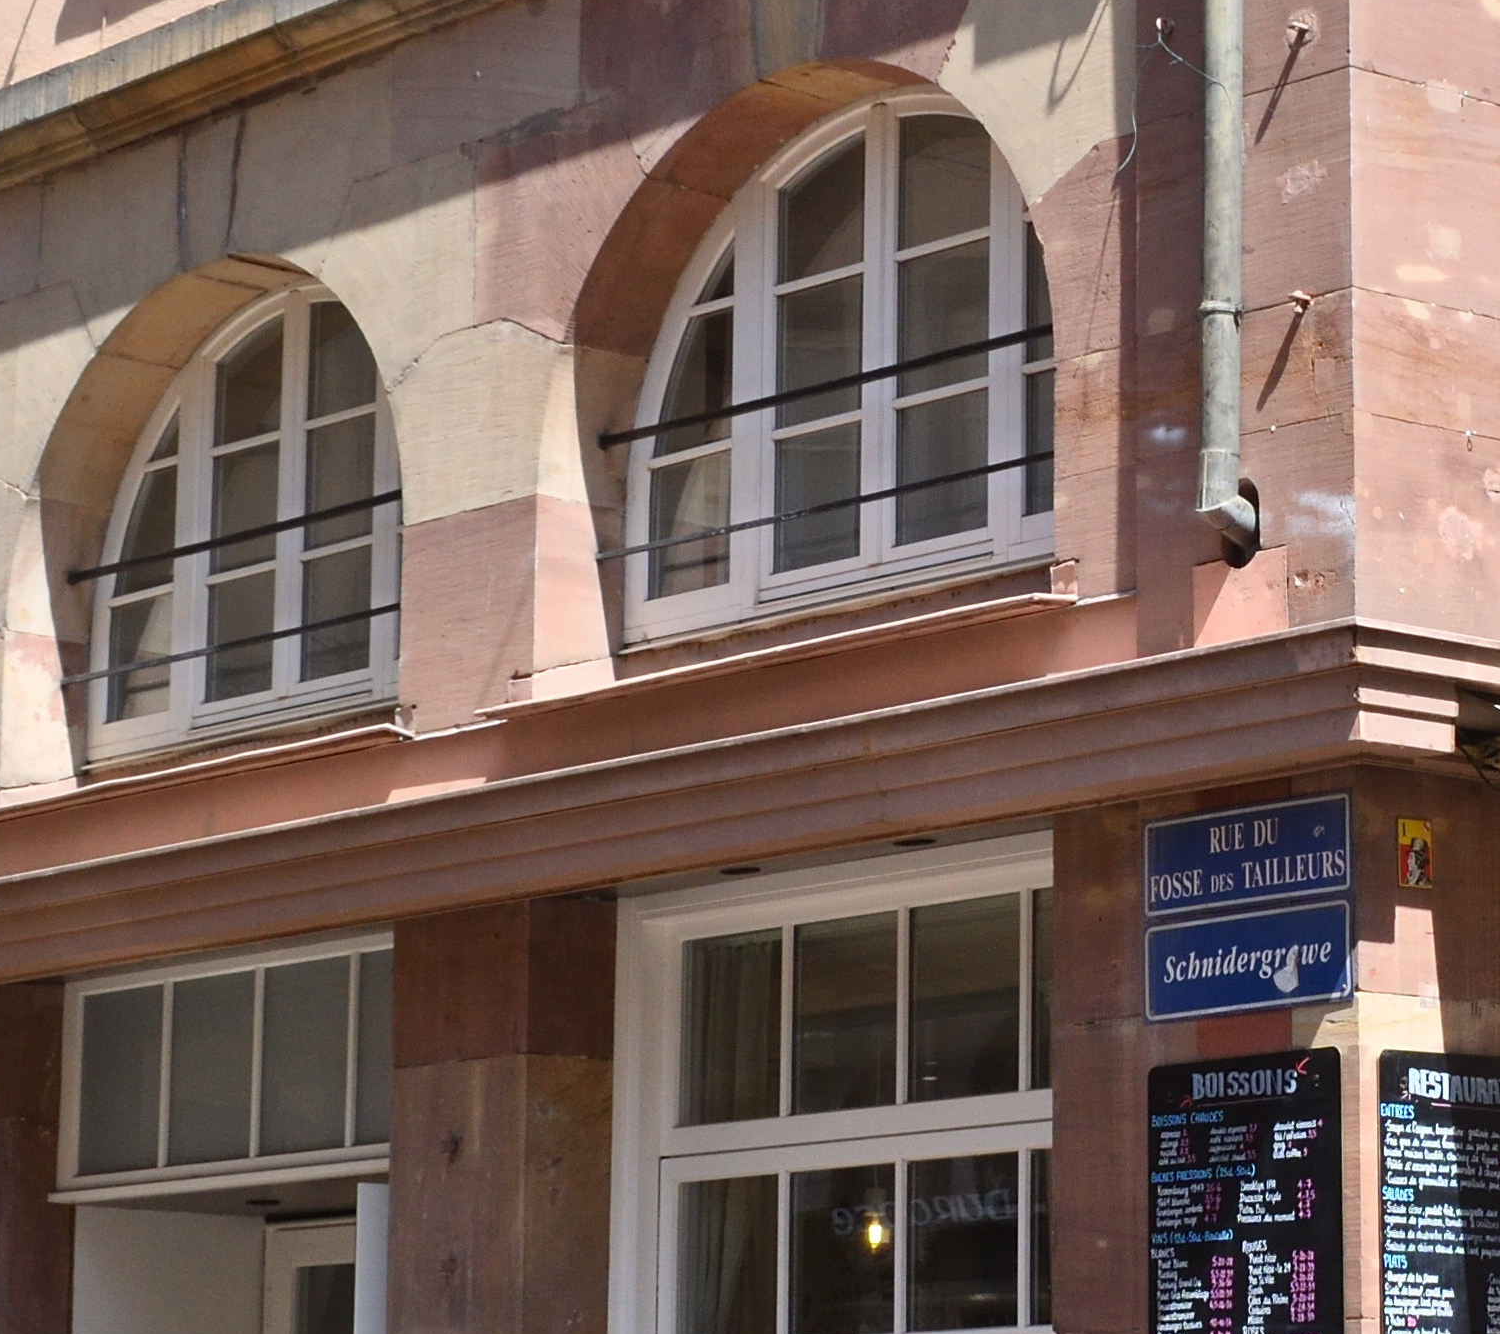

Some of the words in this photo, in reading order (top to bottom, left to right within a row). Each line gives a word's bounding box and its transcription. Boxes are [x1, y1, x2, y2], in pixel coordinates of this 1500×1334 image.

[1209, 823, 1244, 854] RUE
[1254, 818, 1278, 847] DU
[1150, 870, 1202, 903] FOSSE
[1211, 873, 1234, 893] DES
[1242, 849, 1345, 889] TAILLEURS
[1191, 1069, 1298, 1100] BOISSONS
[1380, 1102, 1415, 1119] ENTREES
[1383, 1253, 1407, 1269] PLATS
